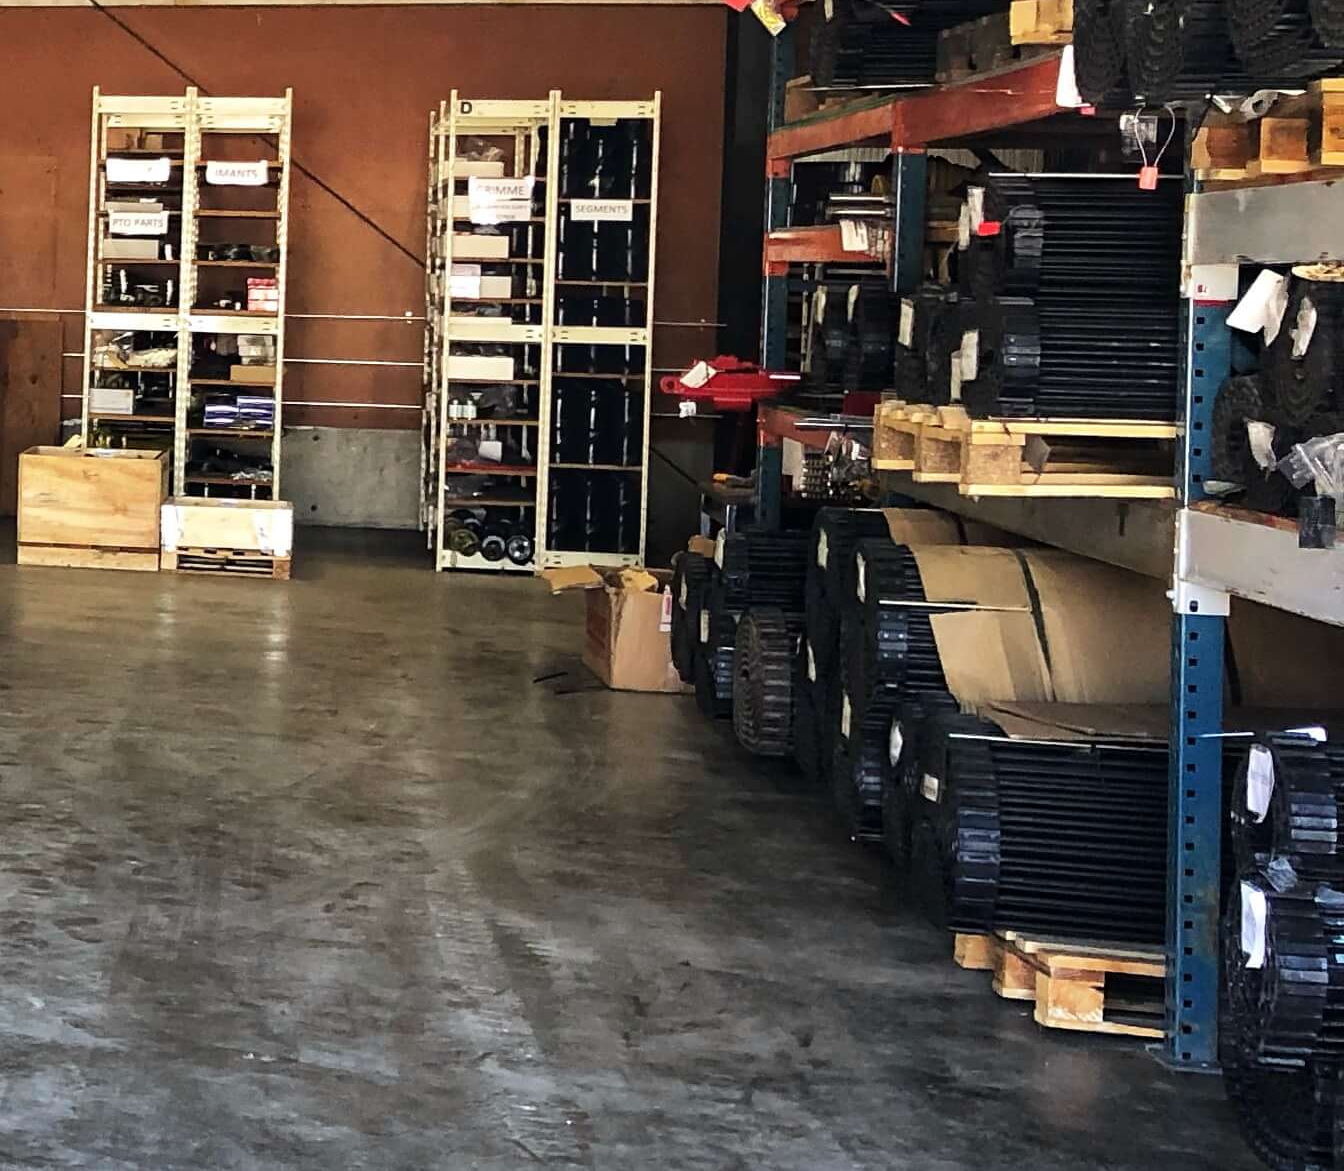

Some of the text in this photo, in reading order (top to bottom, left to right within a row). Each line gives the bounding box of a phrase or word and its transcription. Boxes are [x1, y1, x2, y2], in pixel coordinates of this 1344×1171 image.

[461, 101, 472, 115] D
[215, 168, 259, 179] IMANTS
[575, 203, 628, 215] SEGMENTS
[111, 218, 164, 228] PTO PARTS
